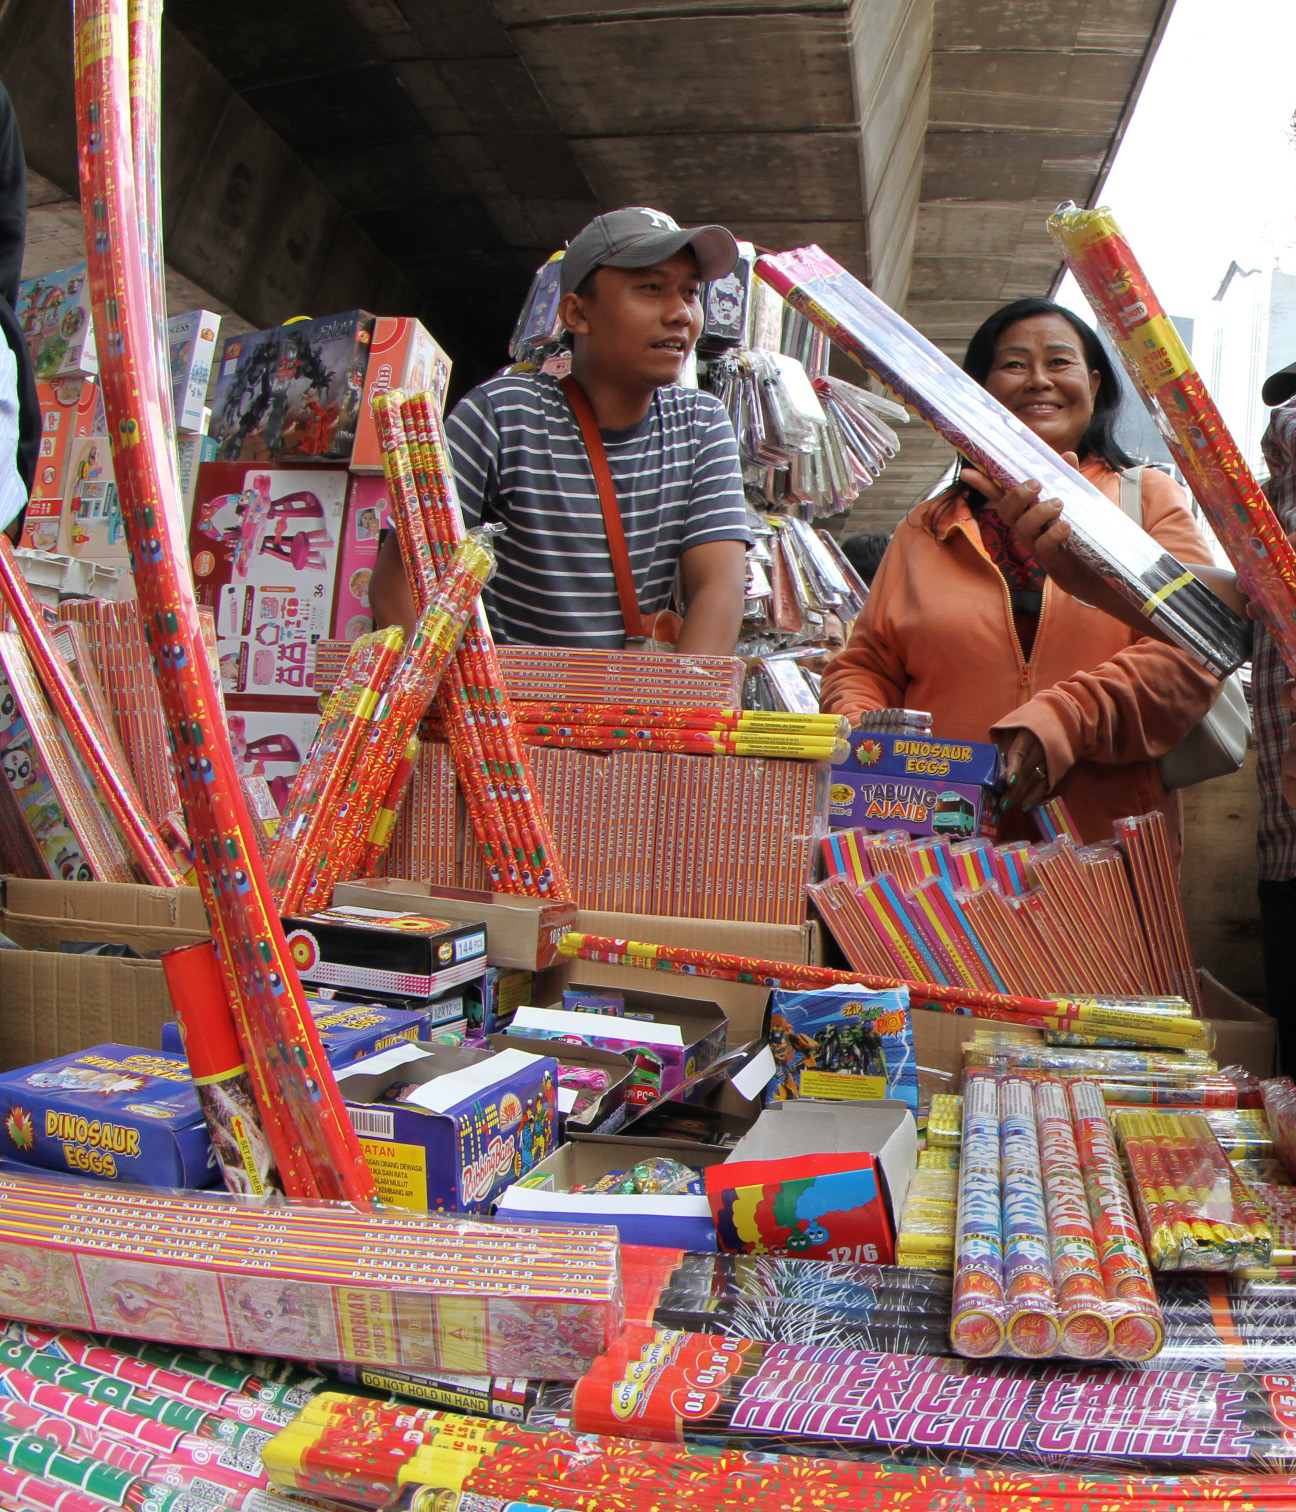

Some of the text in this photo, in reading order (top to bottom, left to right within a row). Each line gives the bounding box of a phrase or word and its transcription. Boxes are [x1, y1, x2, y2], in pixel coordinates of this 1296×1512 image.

[314, 584, 324, 598] 36
[894, 740, 973, 762] DINOSAUR
[905, 758, 949, 776] EGGS
[861, 783, 938, 807] TABUNG
[866, 801, 929, 822] AJAIB
[457, 937, 484, 956] 144 PCS
[453, 1004, 463, 1017] PCS
[45, 1110, 141, 1158] DINOSAUR
[62, 1144, 119, 1178] EGGS
[240, 1139, 264, 1196] SET FIRE HERE
[381, 1160, 399, 1169] ORANG
[399, 1163, 422, 1172] DEWASA
[74, 1203, 288, 1233] PENDEKAR SUPER 200
[82, 1192, 294, 1219] PENDEKAR SUPER 200
[61, 1224, 279, 1258] PENDEKAR SUPER 200
[69, 1214, 285, 1246] PENDEKAR SUPER 200
[364, 1232, 597, 1254] PENDEKAR SUPER 200
[567, 1229, 599, 1238] 200
[51, 1234, 273, 1270] PENDEKAR SUPER 200
[362, 1245, 597, 1269] PENDEKAR SUPER 200
[827, 1243, 878, 1264] 12/6
[352, 1270, 593, 1297] PENDEKAR SUPER 200
[357, 1258, 595, 1283] PENDEKAR SUPER 200
[348, 1292, 367, 1358] PENDEKAR
[370, 1324, 387, 1360] SUPER
[364, 1374, 381, 1388] DO
[383, 1378, 406, 1393] NOT
[408, 1384, 439, 1400] HOLD
[441, 1392, 452, 1403] IN
[453, 1394, 486, 1411] HAND
[729, 1396, 1032, 1450] AMERICAN
